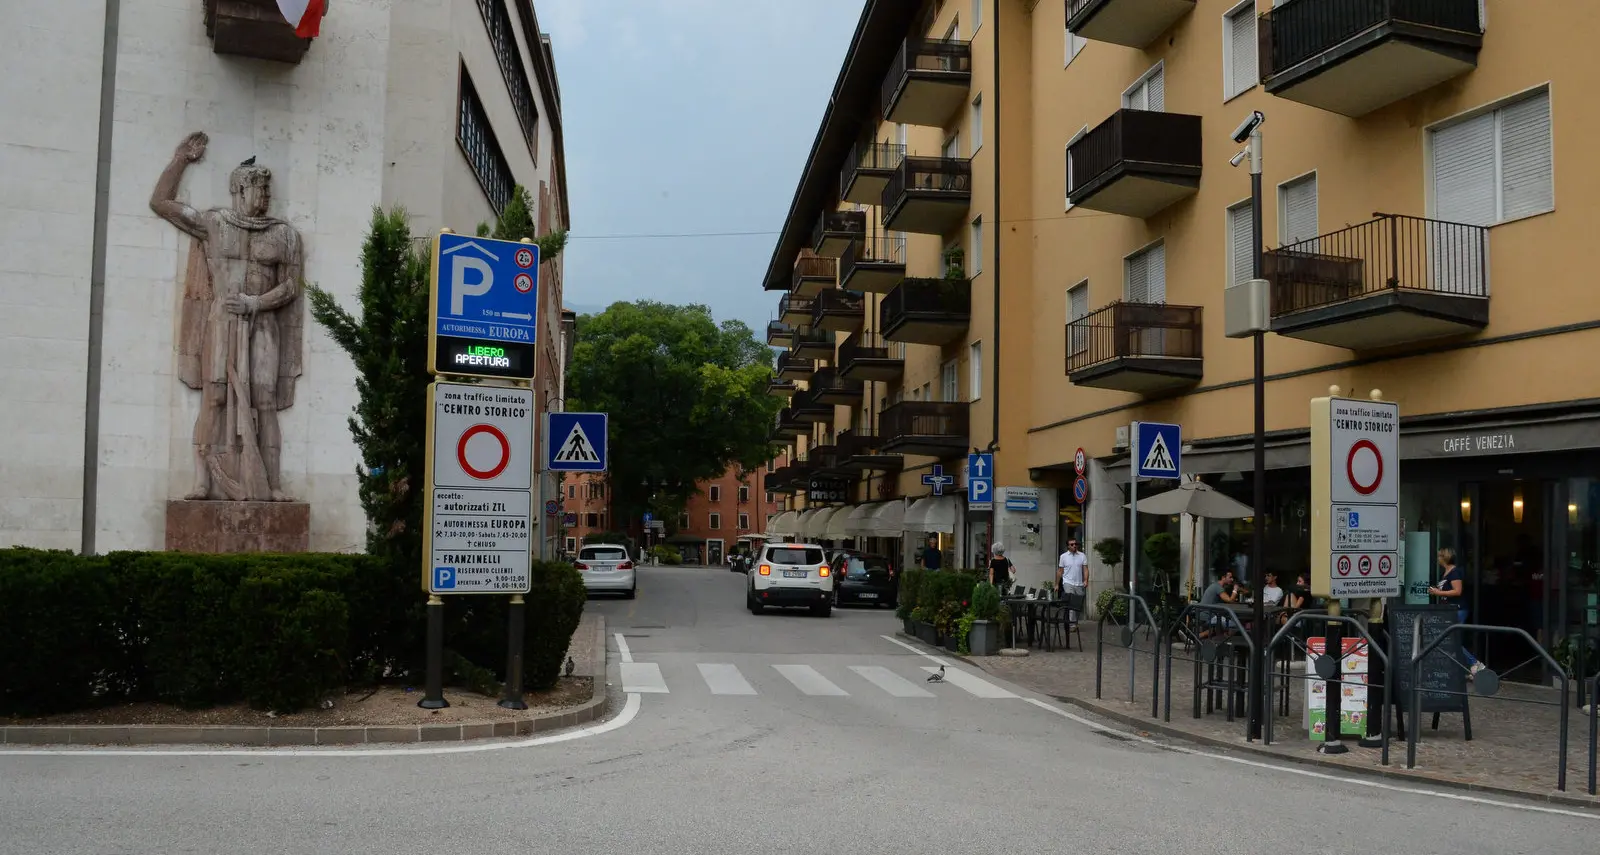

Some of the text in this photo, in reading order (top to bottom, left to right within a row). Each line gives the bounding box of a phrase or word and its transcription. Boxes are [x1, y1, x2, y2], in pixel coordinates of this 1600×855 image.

[451, 255, 494, 315] P
[442, 324, 529, 340] AUTORIMESSA EUROPA
[468, 346, 504, 357] LIBERO
[455, 354, 509, 367] APERTURA
[464, 393, 493, 402] traffico
[496, 395, 526, 404] limitato
[439, 403, 530, 418] "CENTRO STORICO"
[1350, 408, 1370, 417] traffico
[1372, 410, 1392, 418] limitato
[1476, 434, 1515, 449] VENEZIA
[973, 481, 987, 500] P
[444, 503, 490, 512] autorizzati
[492, 503, 506, 512] ZTL
[444, 520, 488, 528] AUTORIMESSA
[491, 520, 526, 529] EUROPA
[444, 555, 500, 564] FRANZINELLI
[439, 570, 450, 586] P
